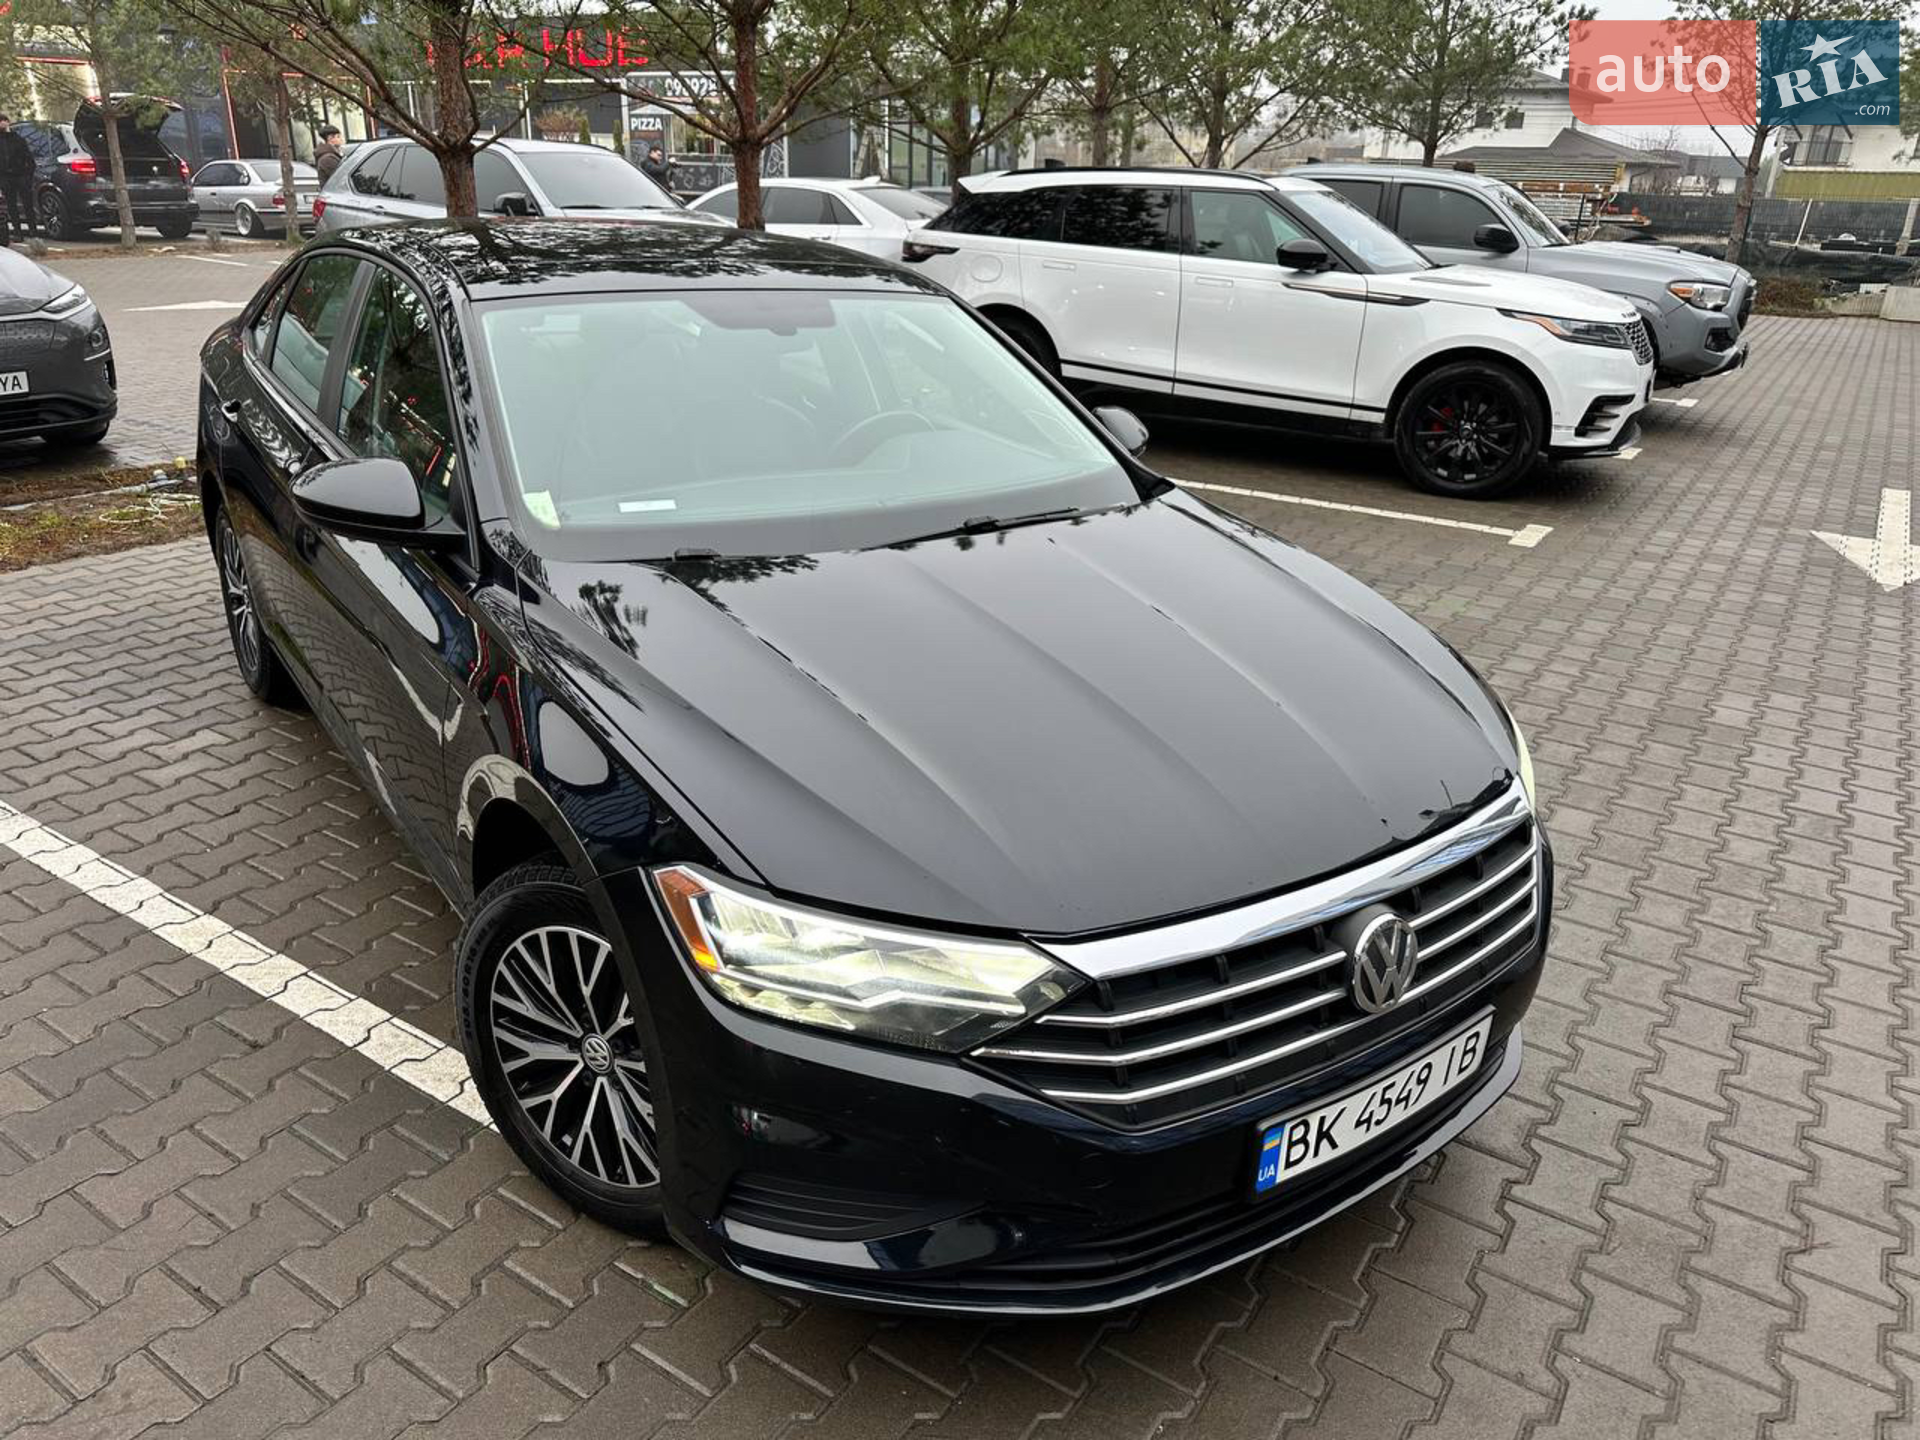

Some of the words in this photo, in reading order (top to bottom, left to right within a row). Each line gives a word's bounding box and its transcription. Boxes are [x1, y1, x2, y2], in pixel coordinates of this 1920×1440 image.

[542, 25, 649, 69] HUE
[631, 117, 663, 130] PIZZA
[1283, 1106, 1347, 1170] BK
[1354, 1061, 1433, 1133] 4549
[1443, 1030, 1481, 1086] IB
[1258, 1163, 1276, 1181] UA
